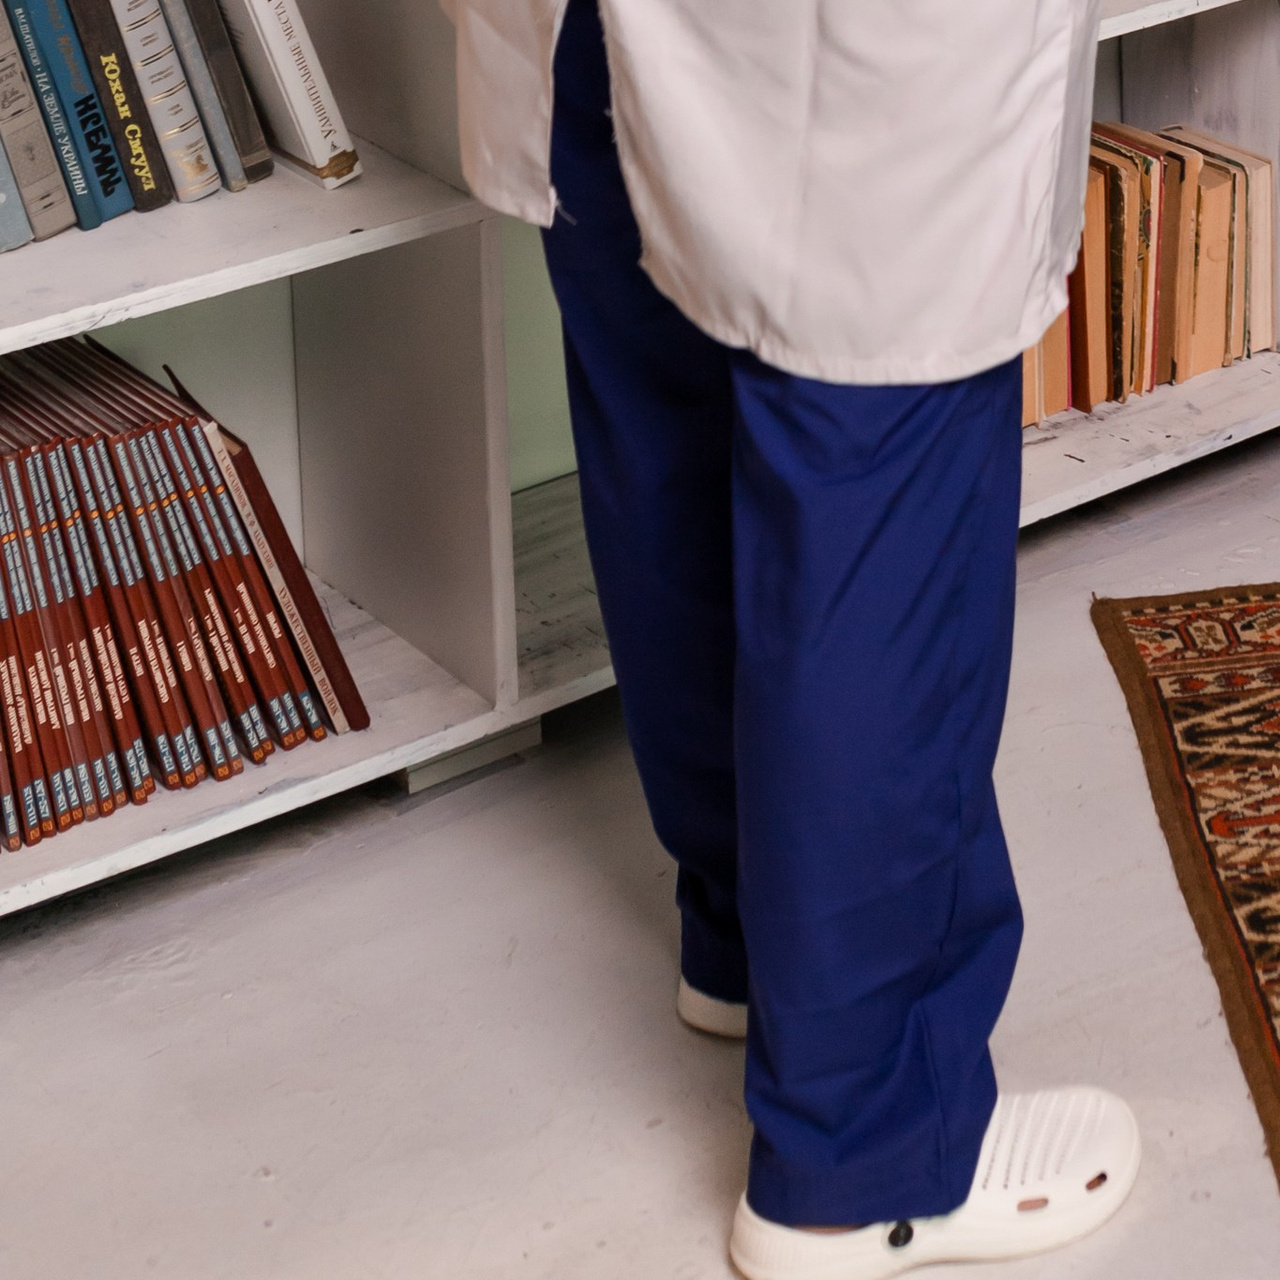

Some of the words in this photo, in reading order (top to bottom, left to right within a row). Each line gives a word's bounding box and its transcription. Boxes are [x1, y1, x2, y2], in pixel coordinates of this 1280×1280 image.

[270, 0, 297, 41] МЕСТА
[34, 71, 52, 92] НА
[286, 42, 338, 139] УДИВИТЕЛЬНЫЕ
[42, 92, 67, 135] ЗЕМЛЕ
[99, 52, 134, 120] Юхан
[121, 123, 156, 192] Смуул
[57, 135, 88, 196] УКРАИНЫ
[276, 586, 324, 673] ХУДОЖЕСТВЕННЫЙ
[319, 677, 341, 714] ВОЙЛОК
